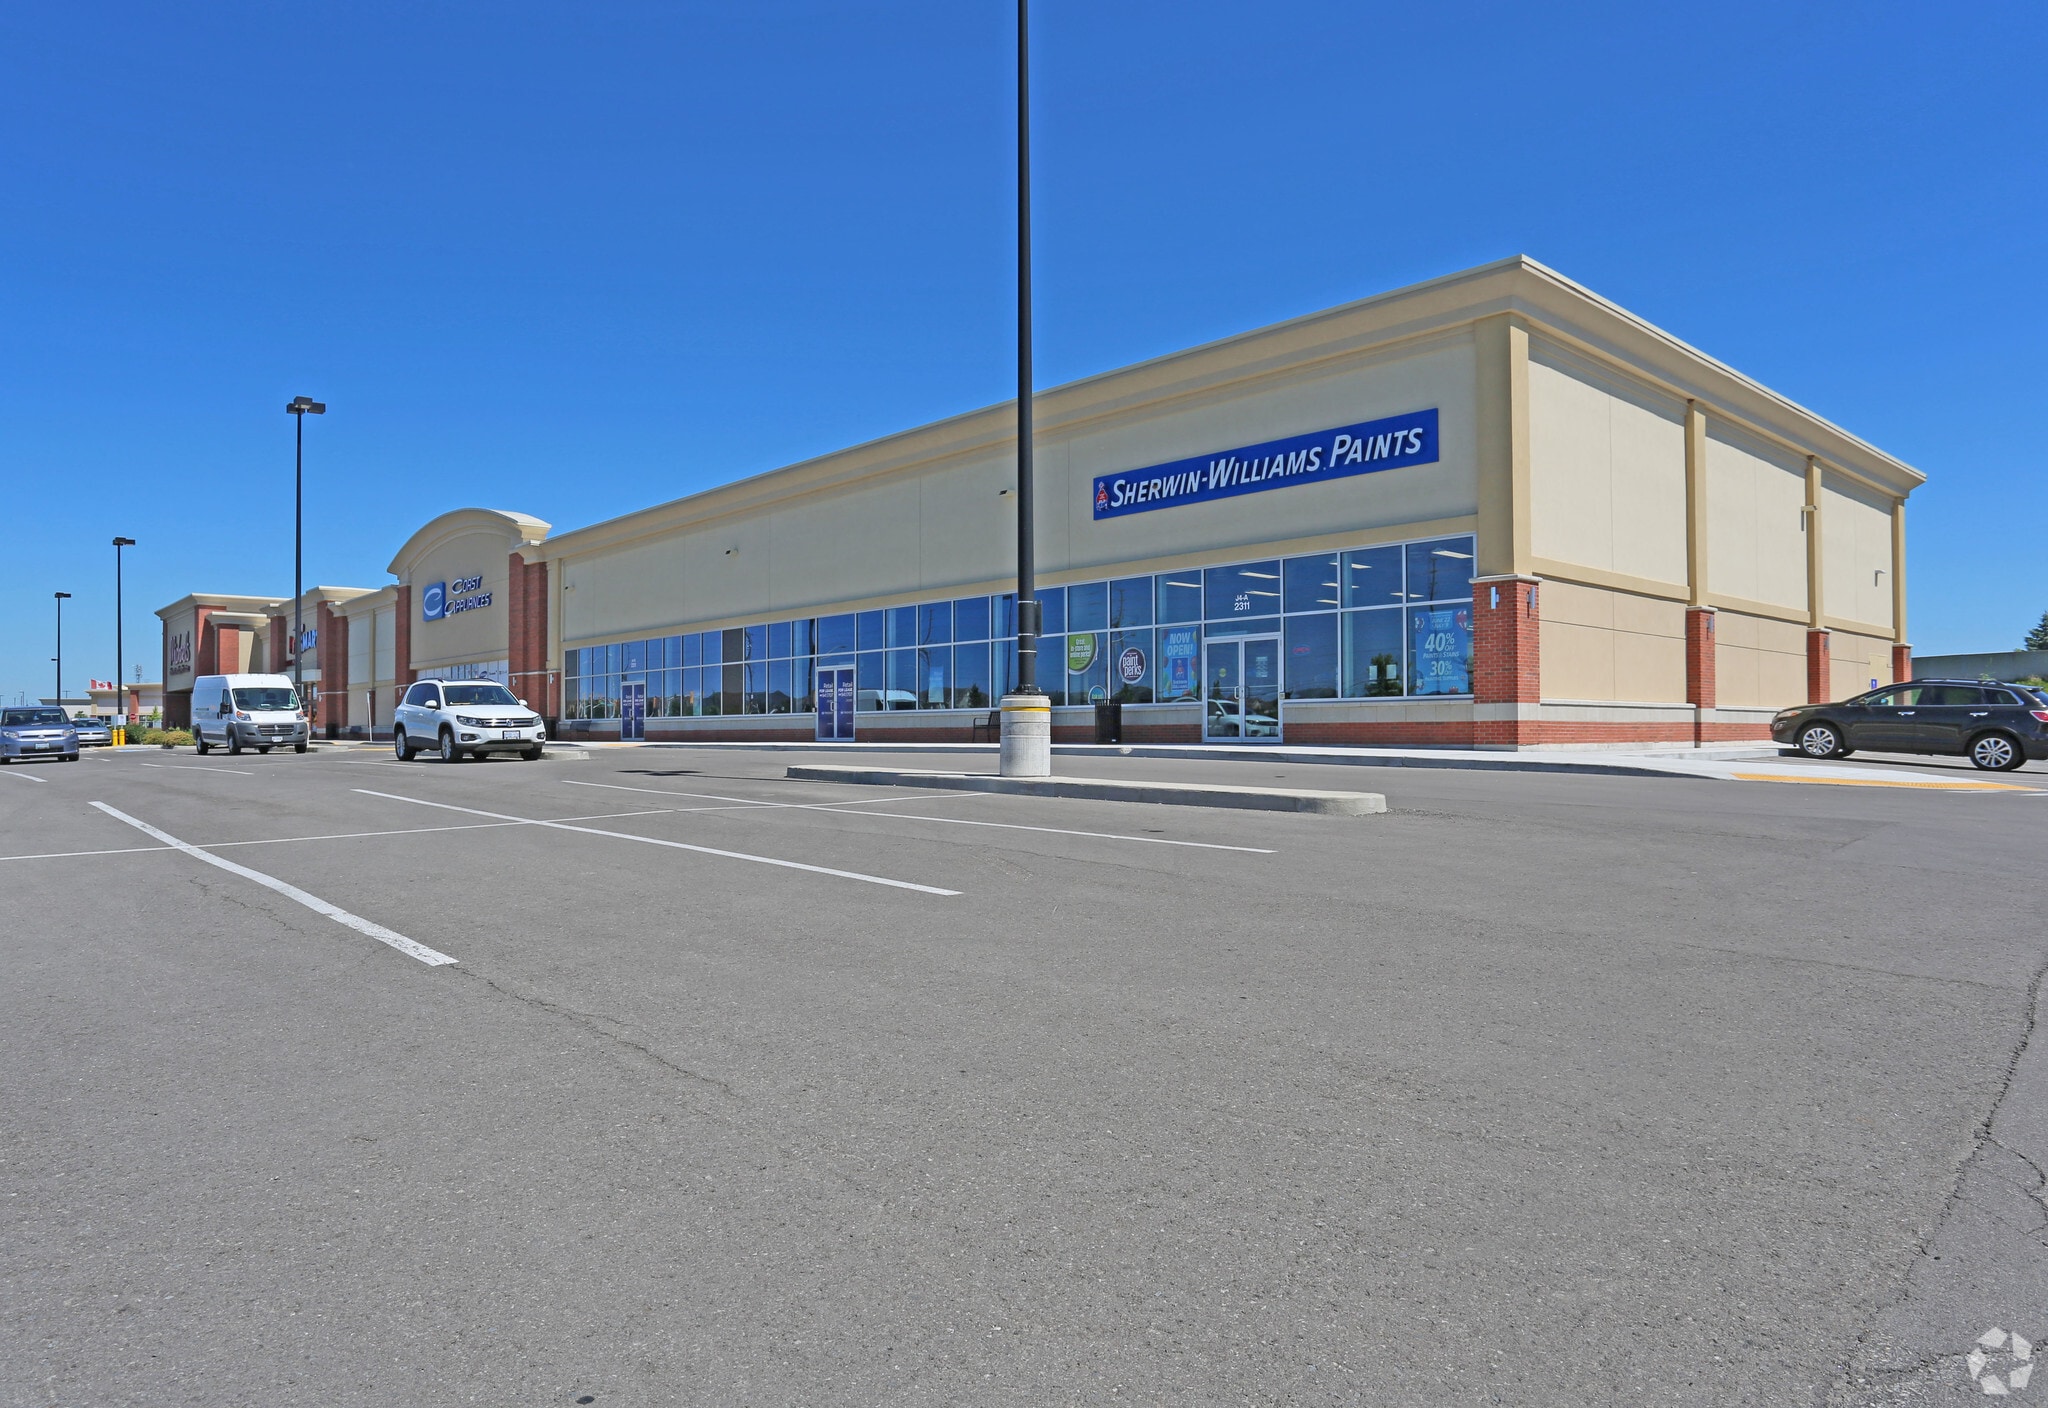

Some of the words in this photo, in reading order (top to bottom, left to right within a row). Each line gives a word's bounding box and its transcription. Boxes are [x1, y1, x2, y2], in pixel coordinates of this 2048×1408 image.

[1329, 427, 1423, 468] PAINTS
[1234, 602, 1250, 611] 2311
[1169, 631, 1191, 645] NOW
[1167, 643, 1194, 656] OPEN!
[1122, 654, 1139, 668] paint
[1124, 665, 1142, 677] perks
